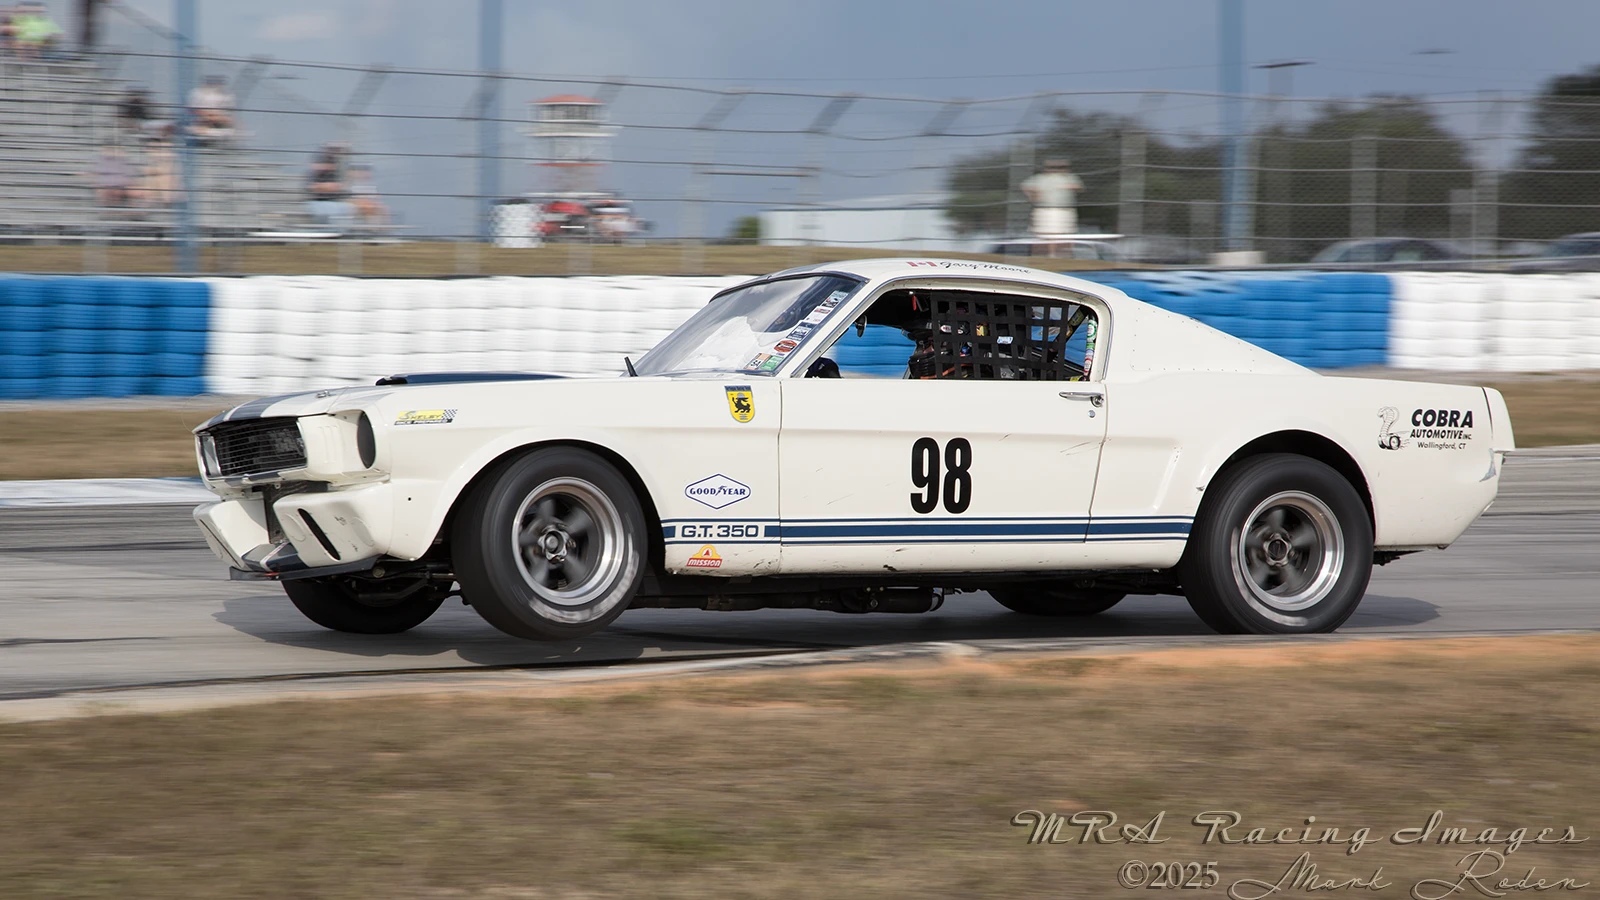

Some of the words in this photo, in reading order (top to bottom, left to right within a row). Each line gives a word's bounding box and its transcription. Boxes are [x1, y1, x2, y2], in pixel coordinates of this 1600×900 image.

[940, 261, 979, 269] Gary
[983, 264, 1031, 274] Moore
[1411, 408, 1473, 428] COBRA
[1410, 429, 1463, 439] AUTOMOTIVE
[911, 437, 972, 514] 98
